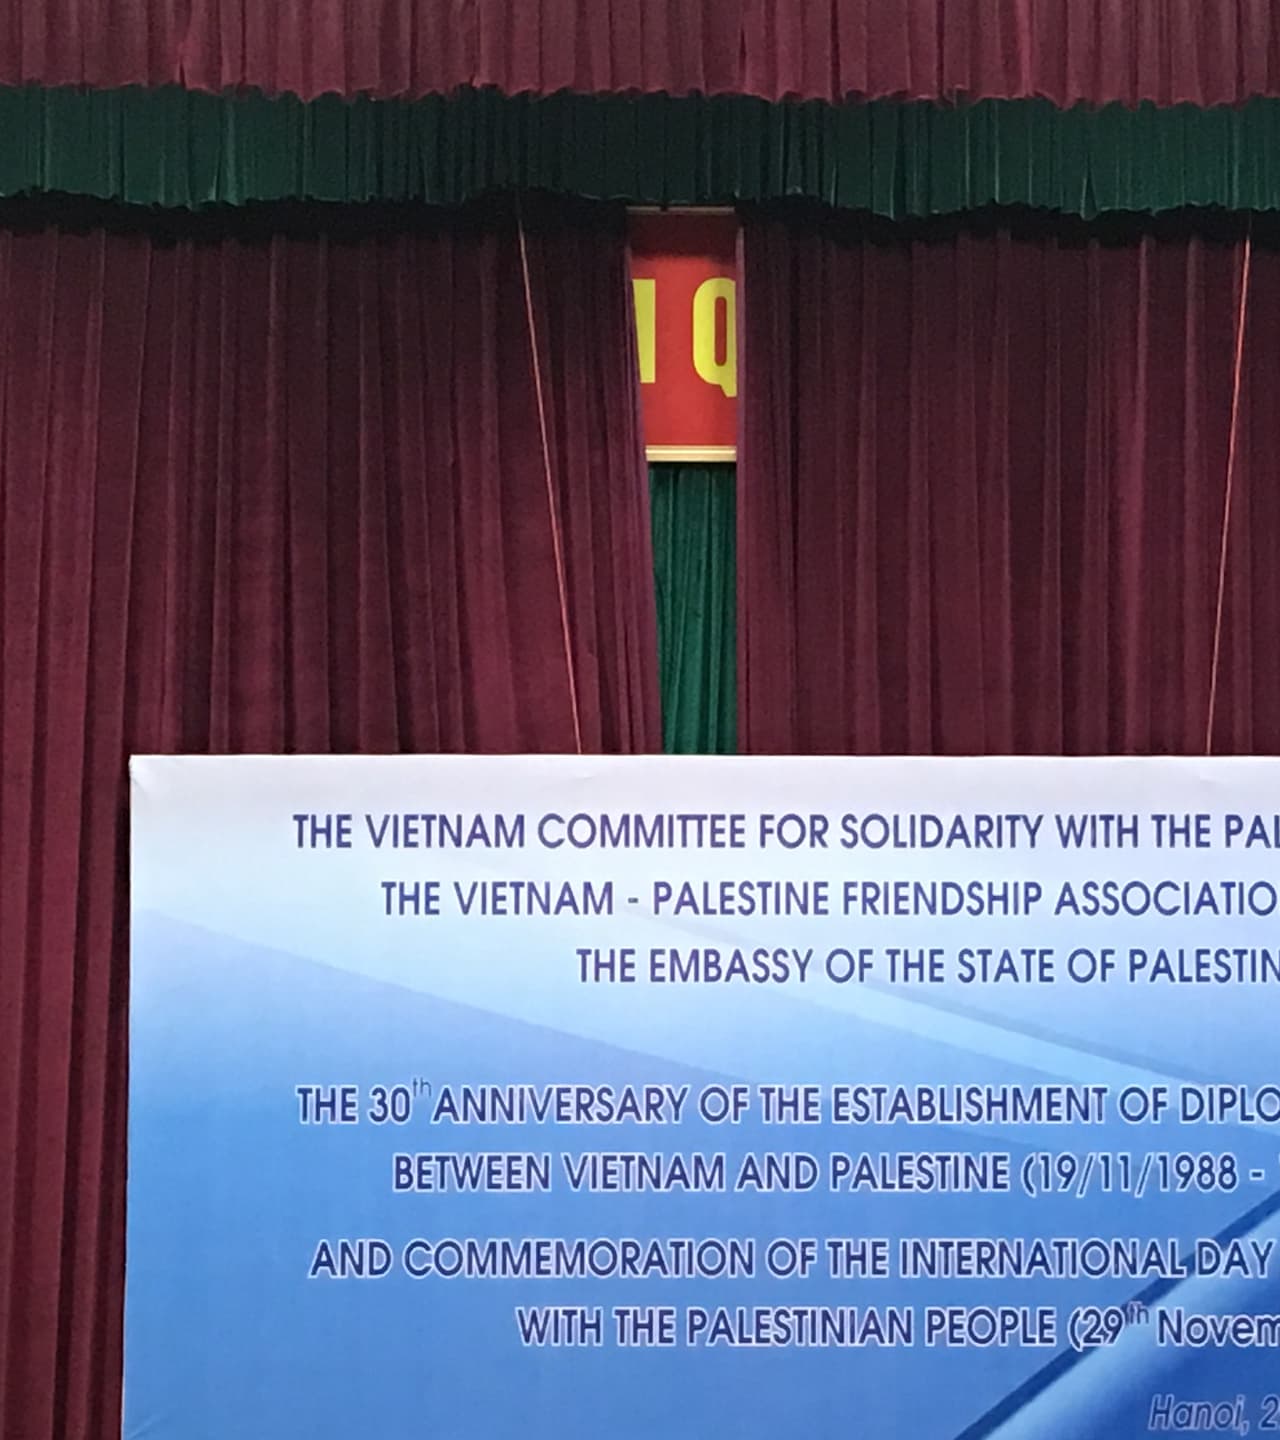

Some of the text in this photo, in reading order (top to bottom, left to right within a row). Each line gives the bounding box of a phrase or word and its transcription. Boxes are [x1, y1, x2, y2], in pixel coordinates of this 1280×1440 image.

[293, 813, 352, 850] THE
[365, 813, 525, 850] VIETNAM
[537, 813, 745, 850] COMMITTEE
[758, 813, 829, 850] FOR
[840, 813, 1043, 851] SOLIDARITY
[1055, 813, 1138, 851] WITH
[1151, 813, 1210, 851] THE
[382, 880, 440, 916] THE
[454, 880, 614, 916] VIETNAM
[653, 880, 828, 917] PALESTINE
[843, 881, 1041, 917] FRIENDSHIP
[577, 948, 636, 984] THE
[649, 948, 814, 984] EMBASSY
[826, 948, 874, 984] OF
[885, 948, 944, 984] THE
[957, 948, 1054, 984] STATE
[1068, 948, 1116, 984] OF
[297, 1084, 357, 1124] THE
[432, 1084, 689, 1124] ANNIVERSARY
[698, 1084, 752, 1125] OF
[760, 1084, 822, 1125] THE
[832, 1085, 1108, 1125] ESTABLISHMENT
[1121, 1085, 1169, 1125] OF
[392, 1152, 551, 1192] BETWEEN
[562, 1152, 725, 1192] VIETNAM
[735, 1152, 818, 1192] AND
[829, 1152, 1010, 1192] PALESTINE
[1023, 1152, 1238, 1197] (19/11/1988
[307, 1239, 393, 1279] AND
[402, 1239, 755, 1279] COMMEMORATION
[766, 1239, 818, 1279] OF
[827, 1239, 889, 1279] THE
[900, 1239, 1188, 1279] INTERNATIONAL
[1195, 1239, 1276, 1279] DAY
[515, 1306, 603, 1346] WITH
[613, 1306, 675, 1346] THE
[686, 1306, 913, 1346] PALESTINIAN
[924, 1307, 1056, 1346] PEOPLE
[1148, 1394, 1249, 1435] Hanoi,
